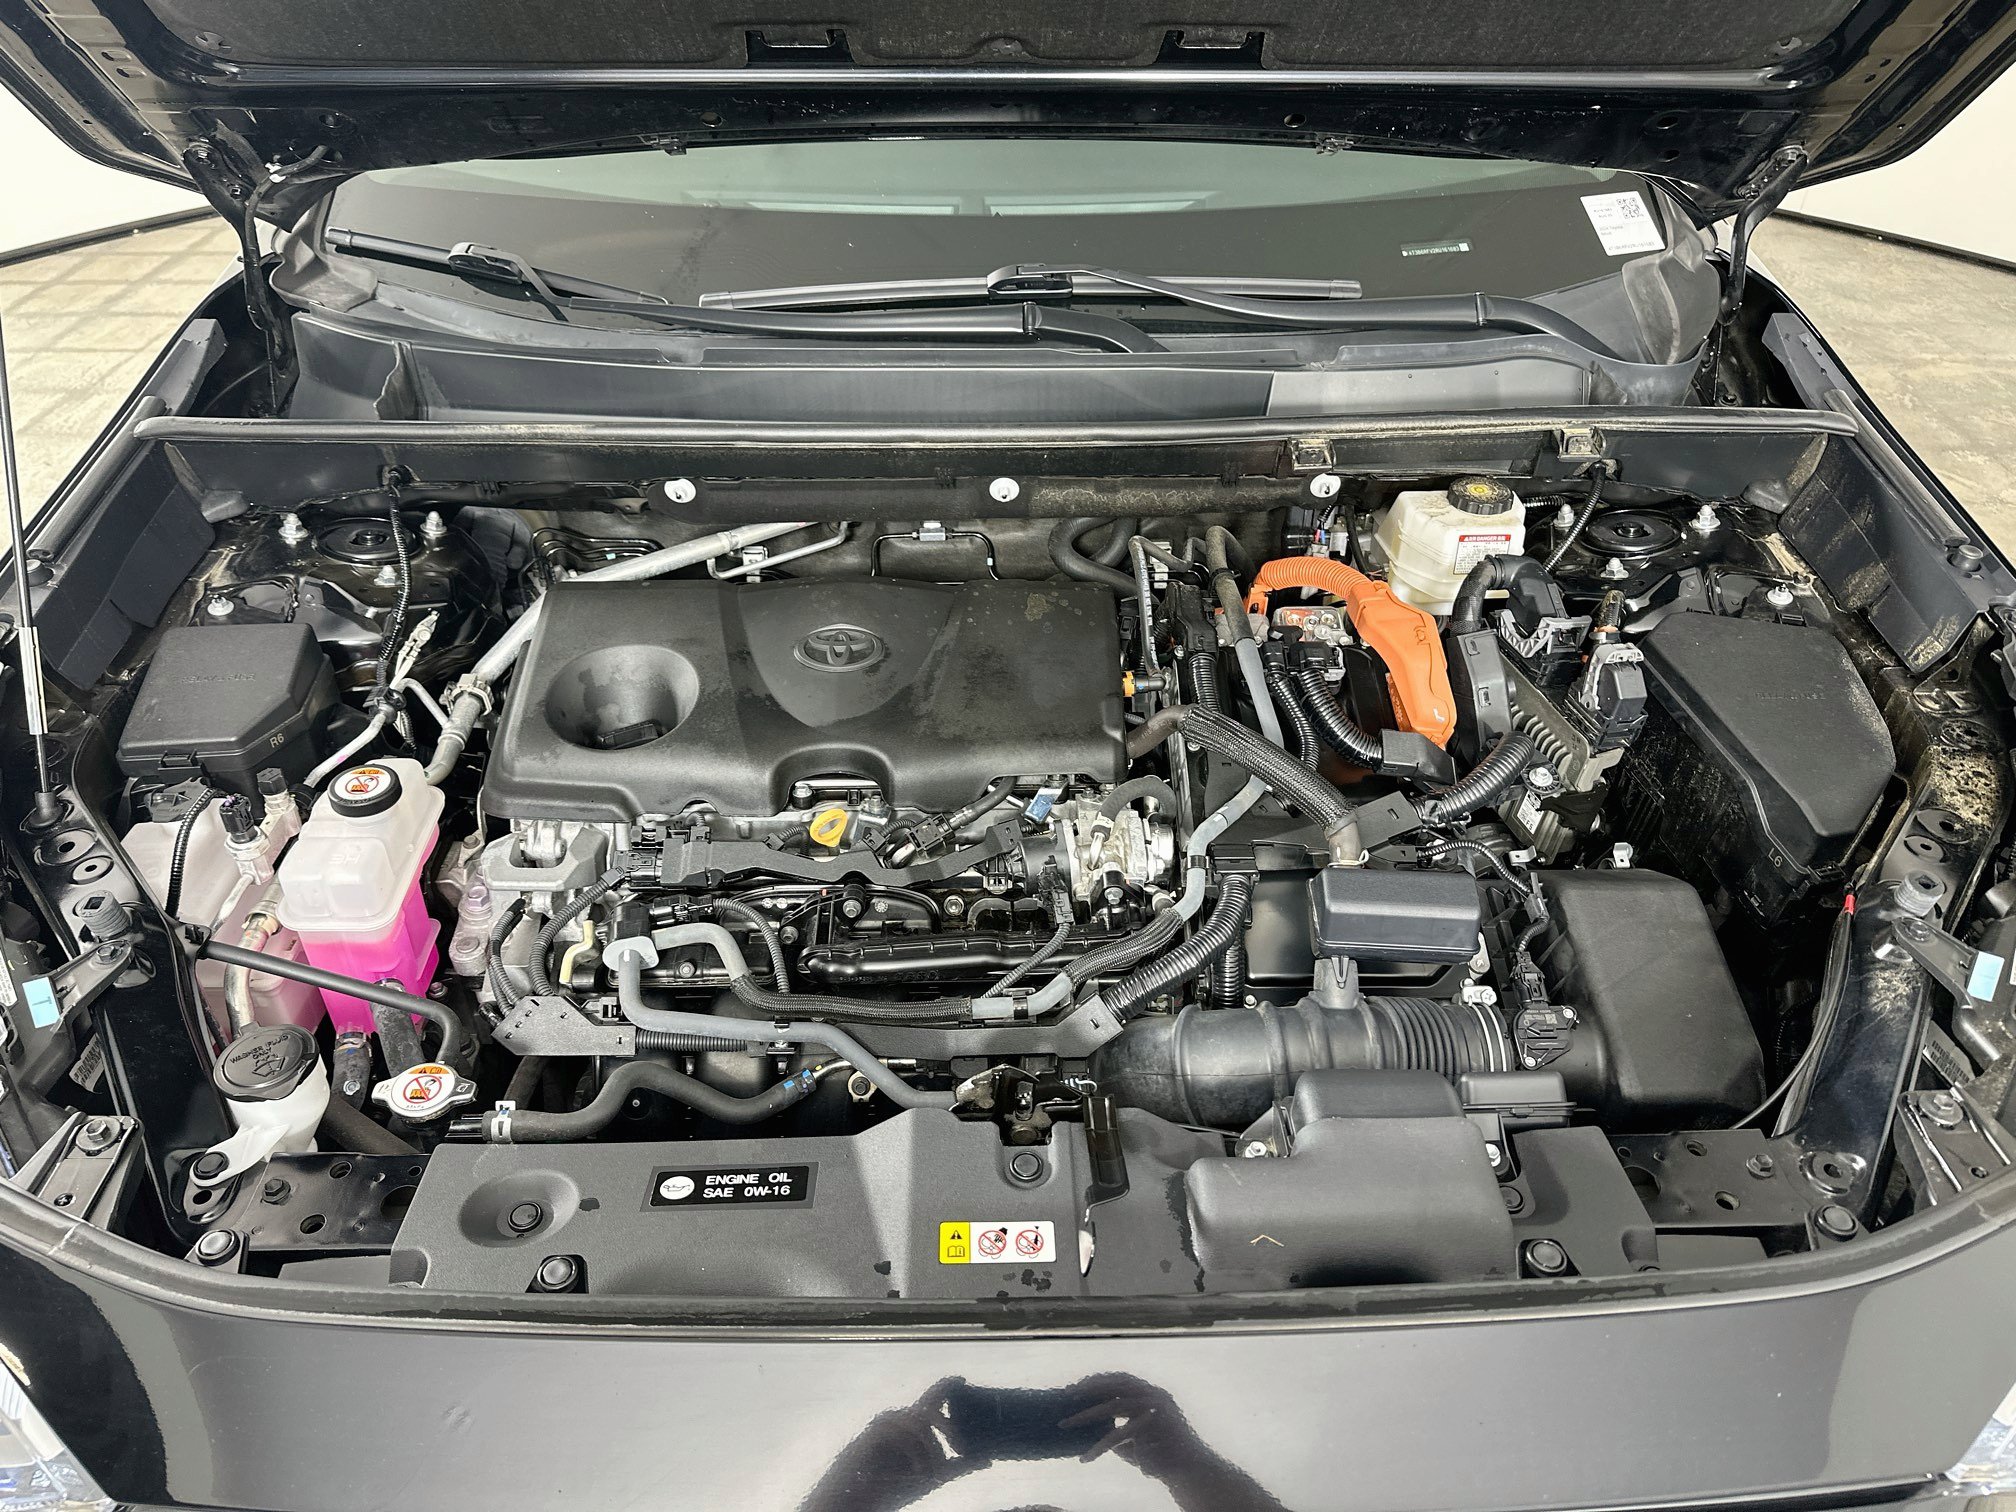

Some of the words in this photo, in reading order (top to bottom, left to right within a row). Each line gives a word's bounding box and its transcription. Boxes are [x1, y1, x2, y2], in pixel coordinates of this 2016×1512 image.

[269, 733, 285, 748] R6
[1768, 847, 1783, 867] L6
[229, 1045, 264, 1064] WASHER
[705, 1173, 760, 1186] ENGINE
[768, 1172, 793, 1183] OIL
[702, 1187, 734, 1198] SAE
[743, 1185, 791, 1197] 0W-16
